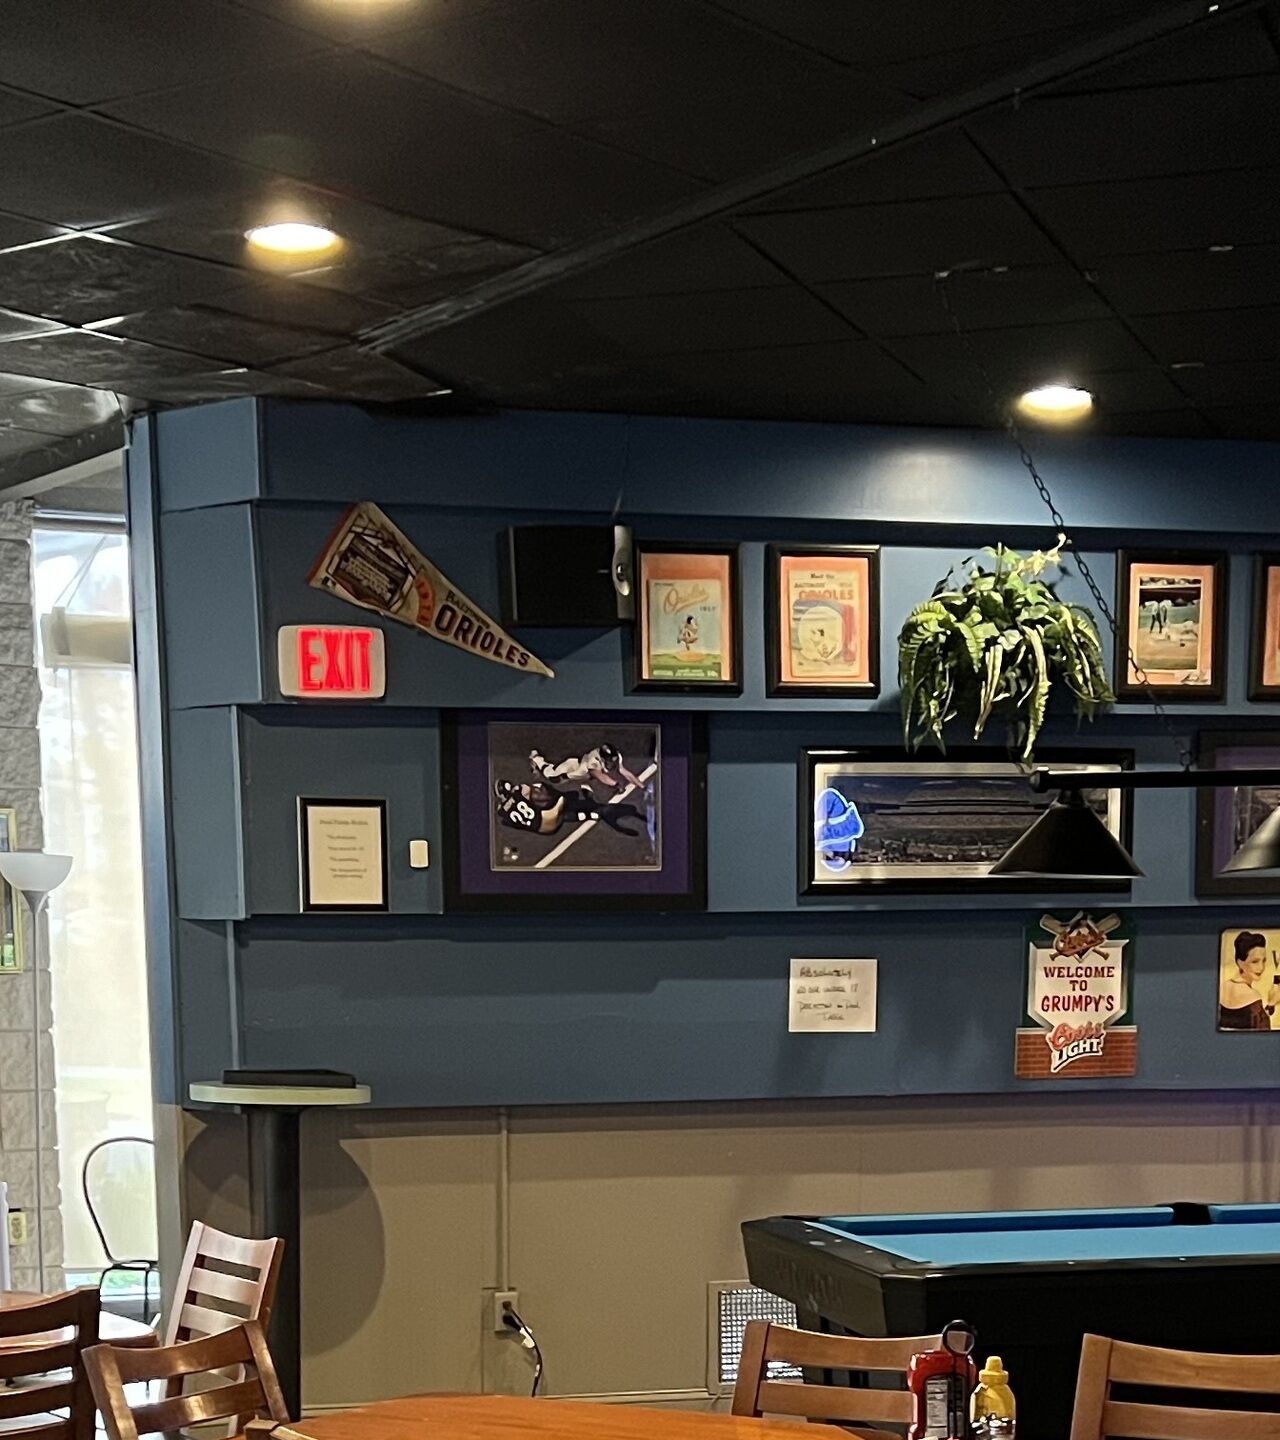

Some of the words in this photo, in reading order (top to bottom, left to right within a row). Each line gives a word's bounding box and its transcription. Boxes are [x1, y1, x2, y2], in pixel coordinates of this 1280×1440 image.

[434, 603, 531, 668] ORIOLES
[299, 629, 373, 692] EXIT
[1043, 966, 1116, 979] WELCOME
[1069, 980, 1088, 992] TO
[1041, 995, 1115, 1012] GRUMPY'S
[1053, 1037, 1101, 1066] LIGHT
